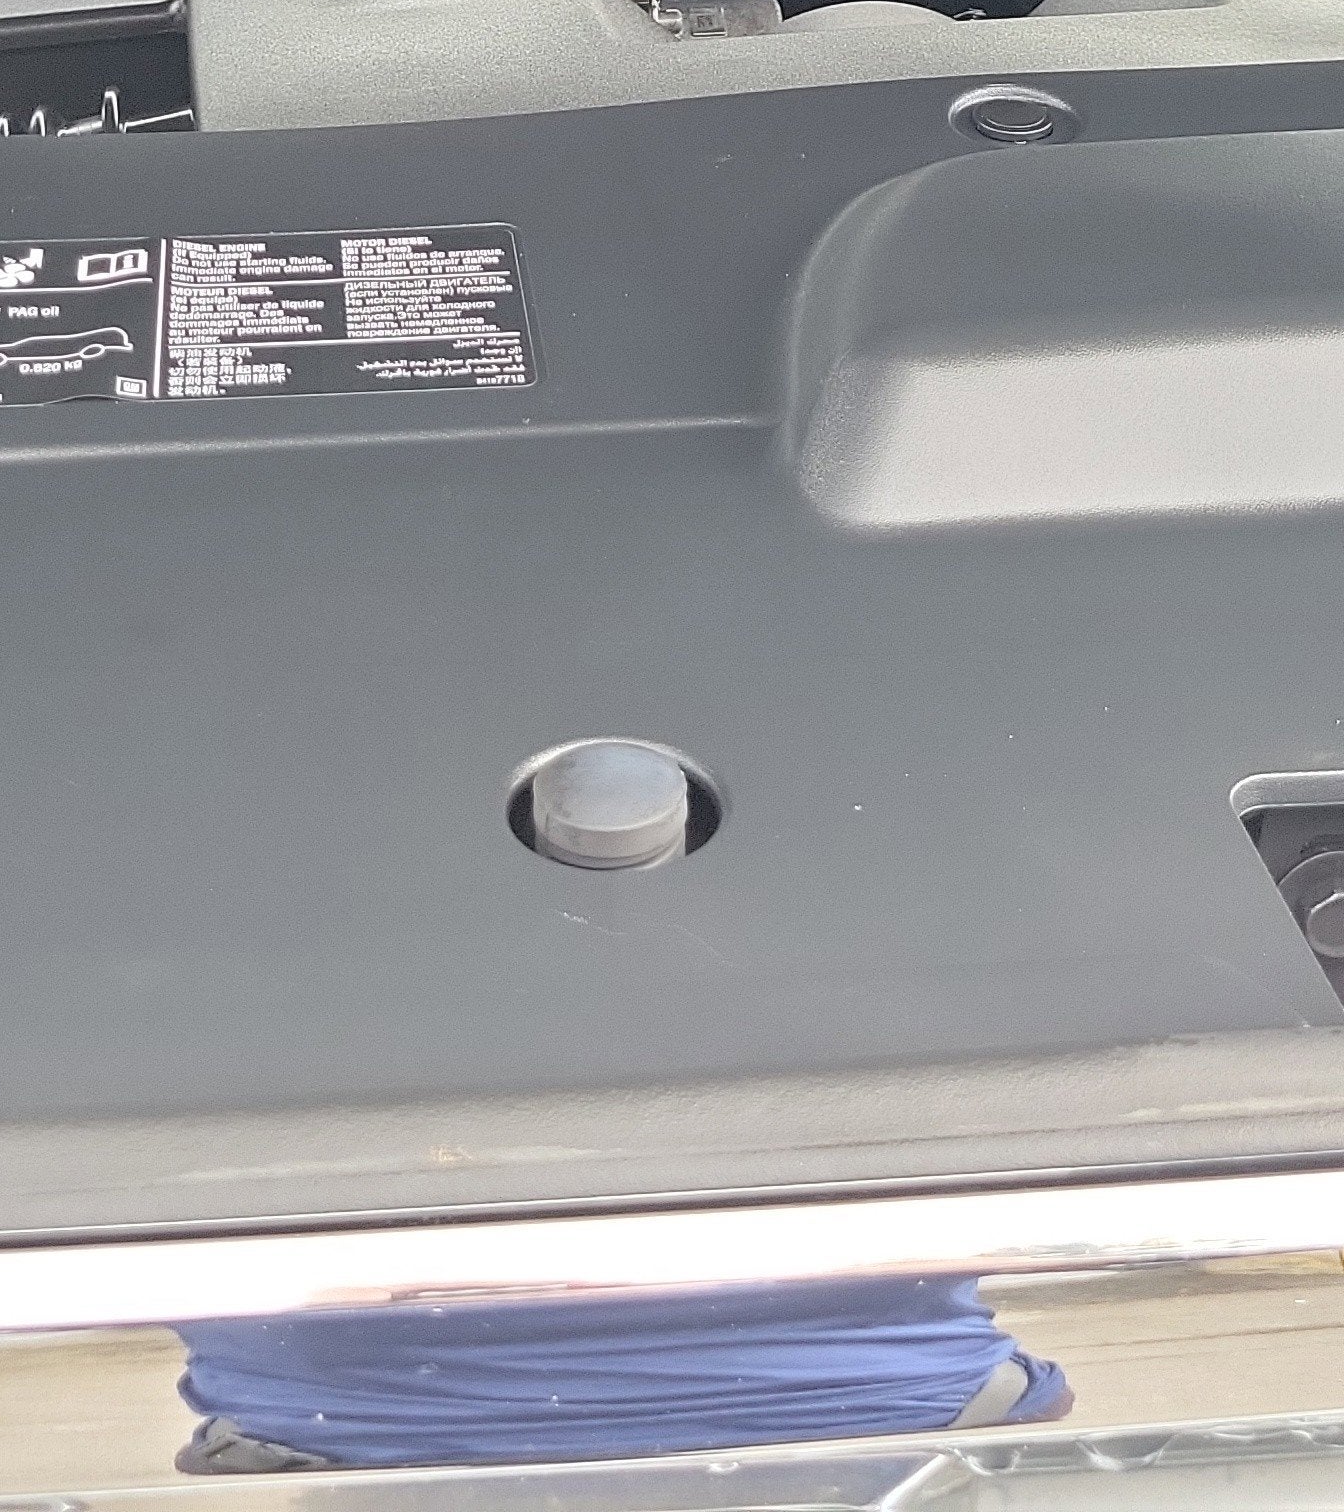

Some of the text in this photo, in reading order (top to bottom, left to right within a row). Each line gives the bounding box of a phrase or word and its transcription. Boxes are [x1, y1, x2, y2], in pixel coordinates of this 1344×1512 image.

[172, 239, 267, 252] DIESEL ENGINE
[341, 236, 433, 248] MOTOR DIESEL
[172, 256, 189, 266] Do
[191, 258, 212, 268] not
[214, 260, 237, 268] use
[239, 257, 286, 268] starting
[342, 254, 359, 263] No
[362, 254, 384, 262] use
[387, 252, 428, 261] fluidos
[430, 250, 446, 258] de
[239, 266, 281, 276] engine
[283, 263, 333, 274] damage
[361, 260, 406, 270] pueden
[171, 273, 194, 283] can
[429, 276, 506, 289] ДВИГАТЕЛЬ
[170, 286, 273, 296] MOTEUR DIESEL
[8, 305, 38, 319] PAG
[41, 305, 60, 318] oil
[190, 303, 214, 313] pas
[189, 327, 234, 336] moteur
[64, 359, 83, 371] kg
